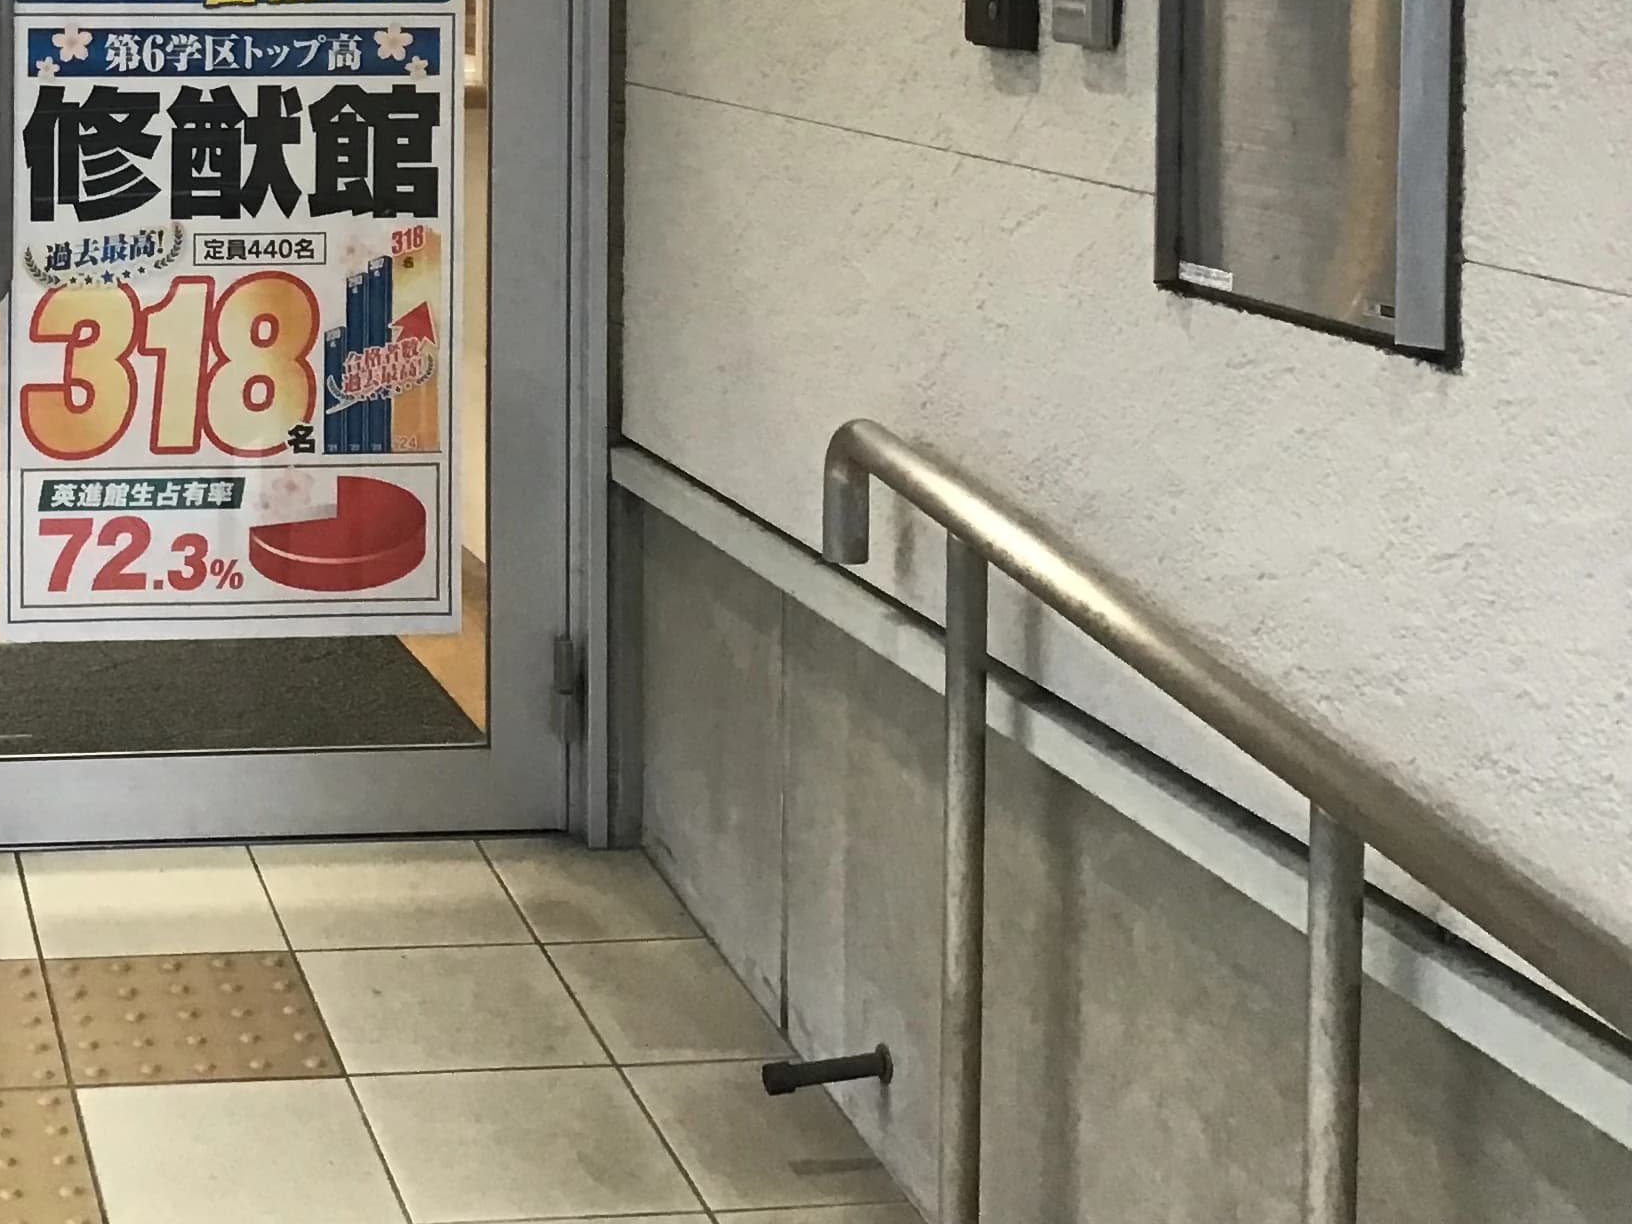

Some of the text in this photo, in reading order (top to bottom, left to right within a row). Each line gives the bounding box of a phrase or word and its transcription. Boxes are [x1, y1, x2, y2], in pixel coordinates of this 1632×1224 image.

[104, 33, 364, 72] 第6学区トップ高
[23, 85, 440, 222] 修猷館
[44, 230, 164, 272] 過去最高!
[203, 237, 316, 261] 定員440名
[392, 225, 424, 256] 318
[20, 271, 320, 461] 318
[51, 480, 235, 508] 英進館生占有率
[38, 515, 244, 593] 72.3%
